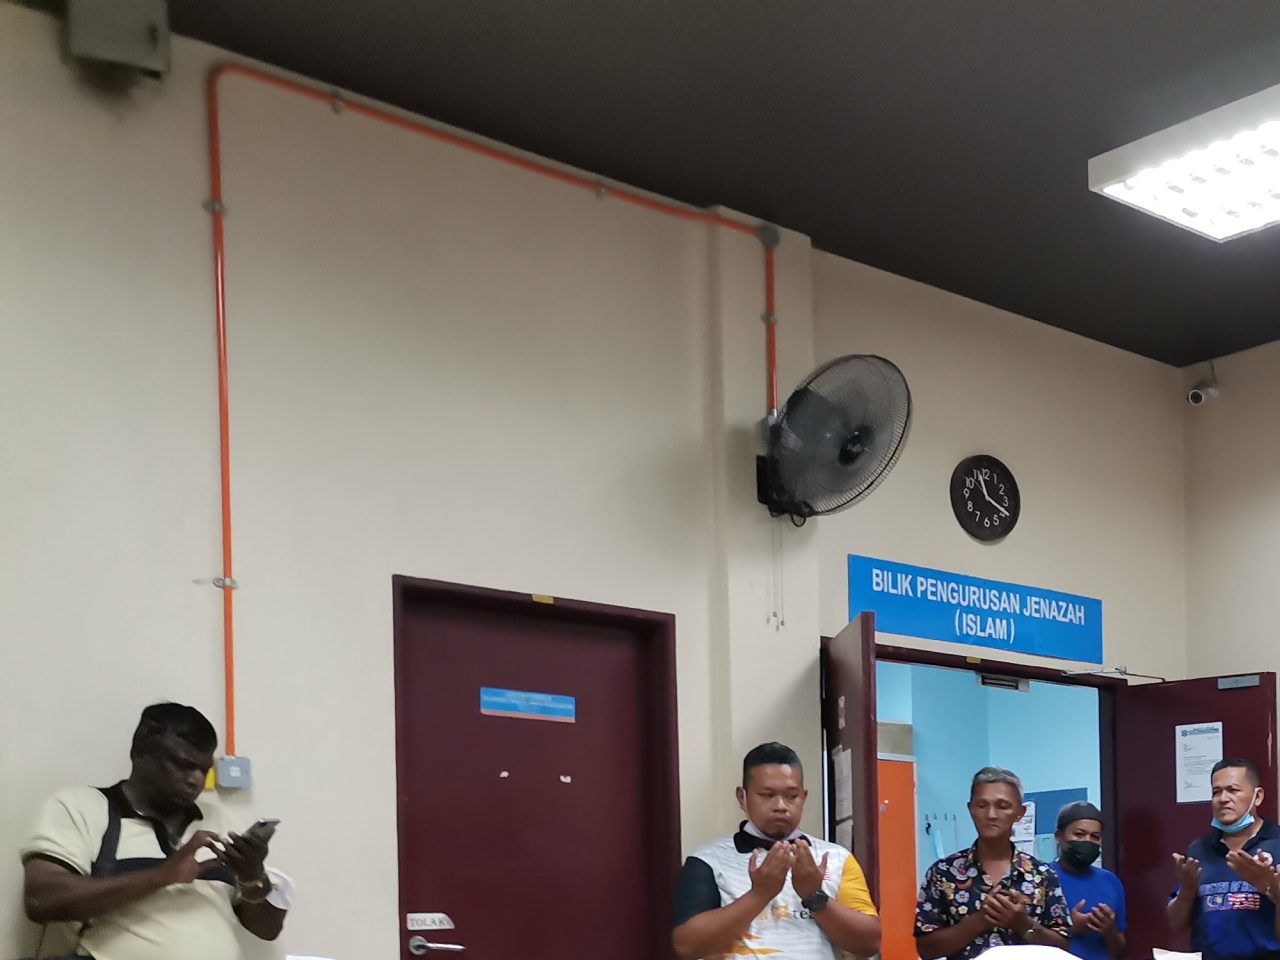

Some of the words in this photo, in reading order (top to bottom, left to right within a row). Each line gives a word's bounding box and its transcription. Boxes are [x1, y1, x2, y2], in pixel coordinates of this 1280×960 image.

[982, 468, 990, 481] 12
[965, 477, 975, 489] 10
[999, 483, 1005, 495] 2
[963, 488, 970, 500] 9
[967, 500, 973, 512] 8
[1003, 495, 1009, 507] 3
[975, 510, 981, 522] 7
[984, 516, 991, 528] 6
[993, 514, 1000, 526] 5
[872, 568, 914, 598] BILIK
[916, 575, 1021, 615] PENGURUSAN
[1022, 595, 1086, 626] JENAZAH
[954, 608, 1016, 645] (ISLAM)
[409, 918, 447, 928] TOLAK
